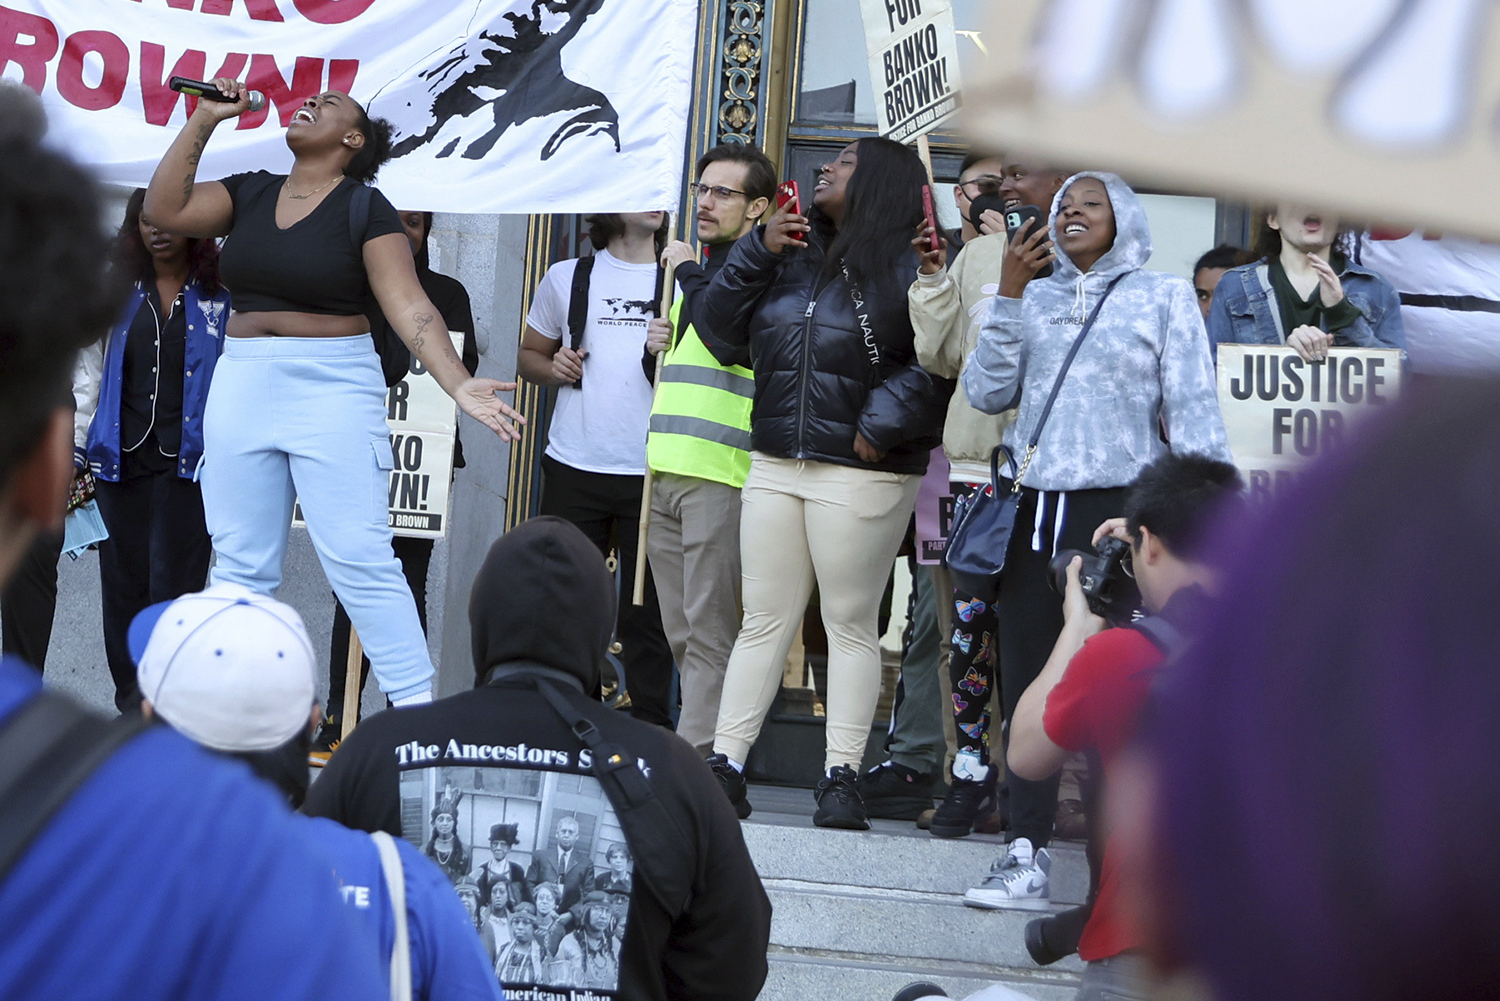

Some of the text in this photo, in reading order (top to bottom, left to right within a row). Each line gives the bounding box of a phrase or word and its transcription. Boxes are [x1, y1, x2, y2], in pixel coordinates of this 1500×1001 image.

[883, 23, 939, 88] BANKO
[883, 55, 951, 128] BROWN!
[1230, 353, 1387, 405] JUSTICE
[396, 514, 429, 529] BROWN
[394, 740, 440, 766] The
[443, 738, 569, 767] Ancestors
[502, 985, 567, 1001] merican
